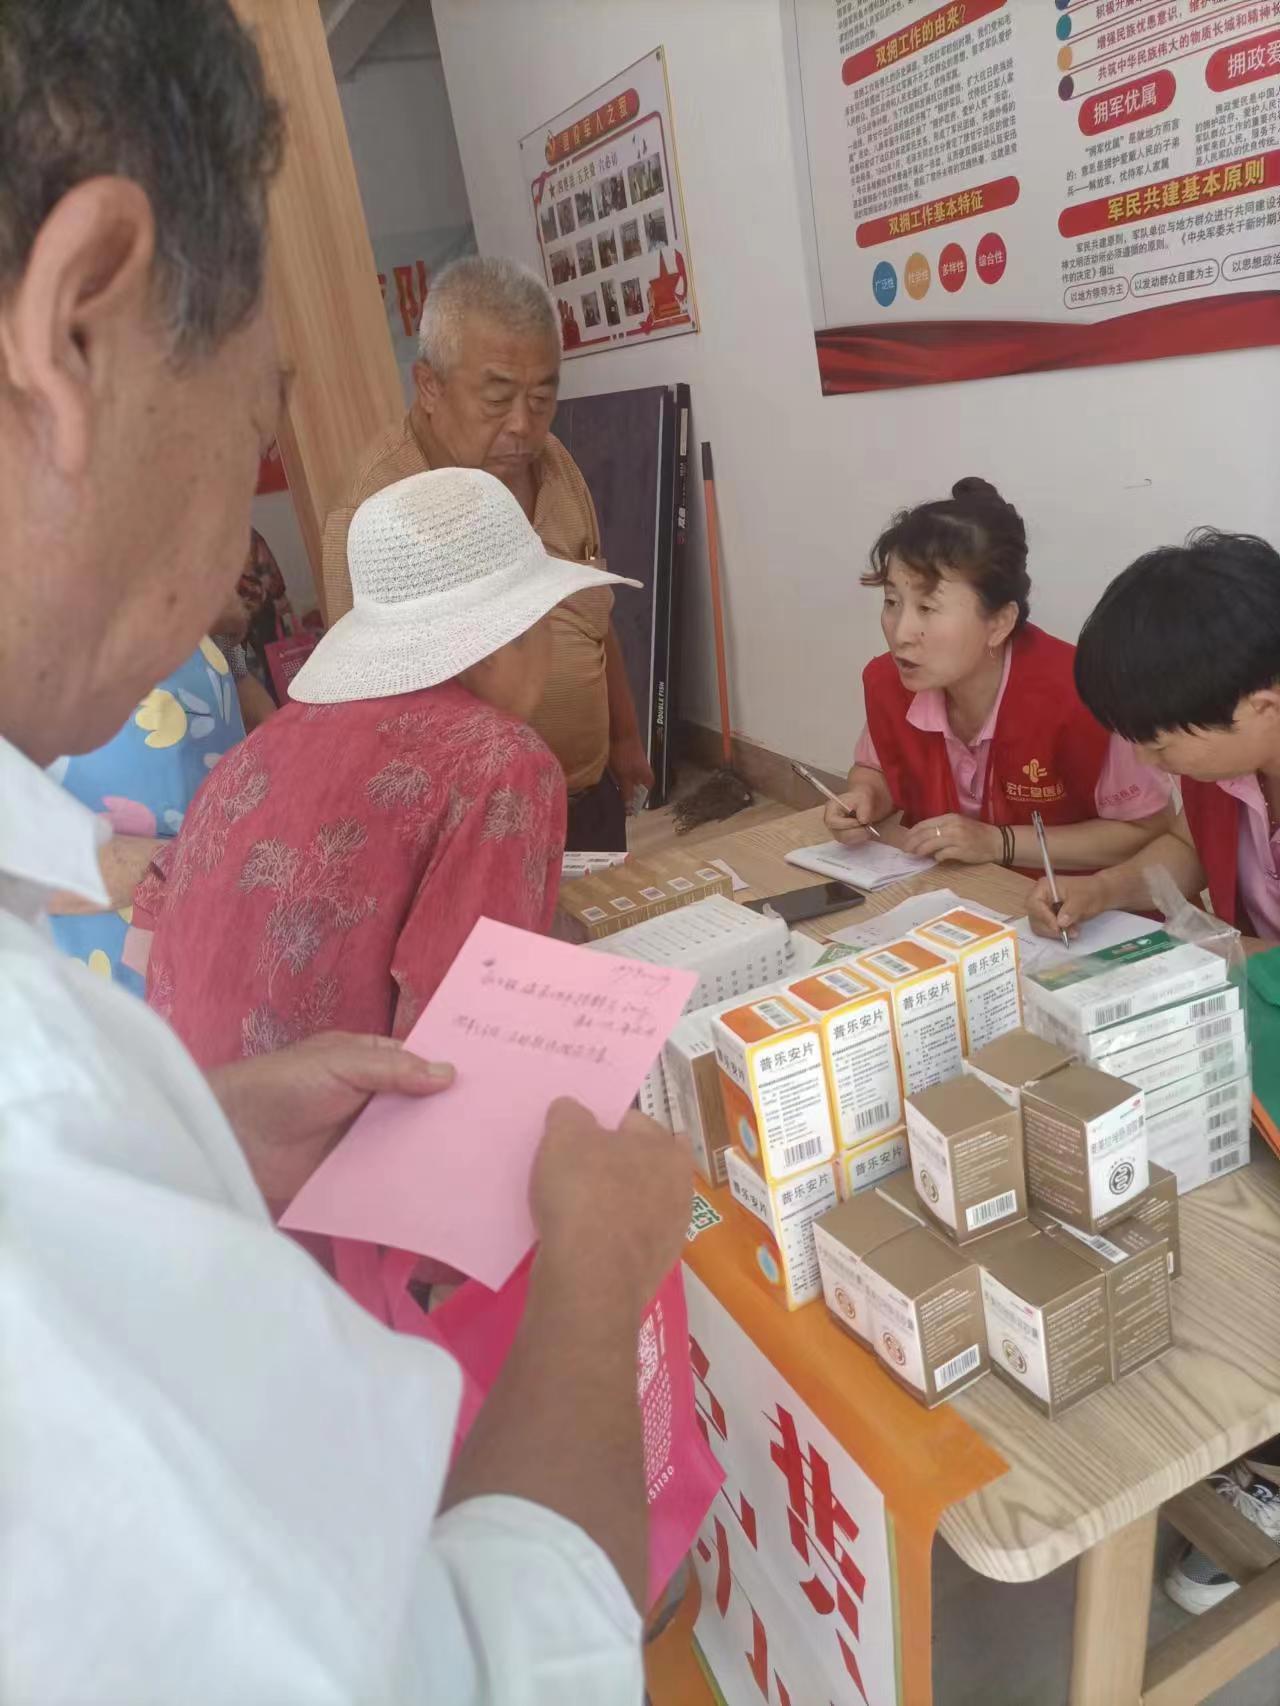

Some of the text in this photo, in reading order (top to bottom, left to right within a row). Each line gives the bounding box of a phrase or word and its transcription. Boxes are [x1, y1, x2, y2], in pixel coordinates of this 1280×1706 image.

[1093, 82, 1157, 126] 拥军优属
[1108, 157, 1265, 221] 军民共建基本原则
[889, 190, 983, 235] 双拥工作基本特征
[942, 261, 965, 276] 多样性
[978, 251, 1004, 267] 综合性
[1070, 283, 1124, 303] 以地方领导为主
[1134, 264, 1214, 291] 以发动群众自建为主
[967, 948, 1010, 977] 普乐安片
[903, 983, 951, 1010] 普乐安片
[832, 1009, 884, 1040] 普乐安片
[760, 1041, 815, 1073] 普乐安片
[855, 1146, 902, 1177] 普乐安片
[781, 1173, 829, 1206] 普乐安片
